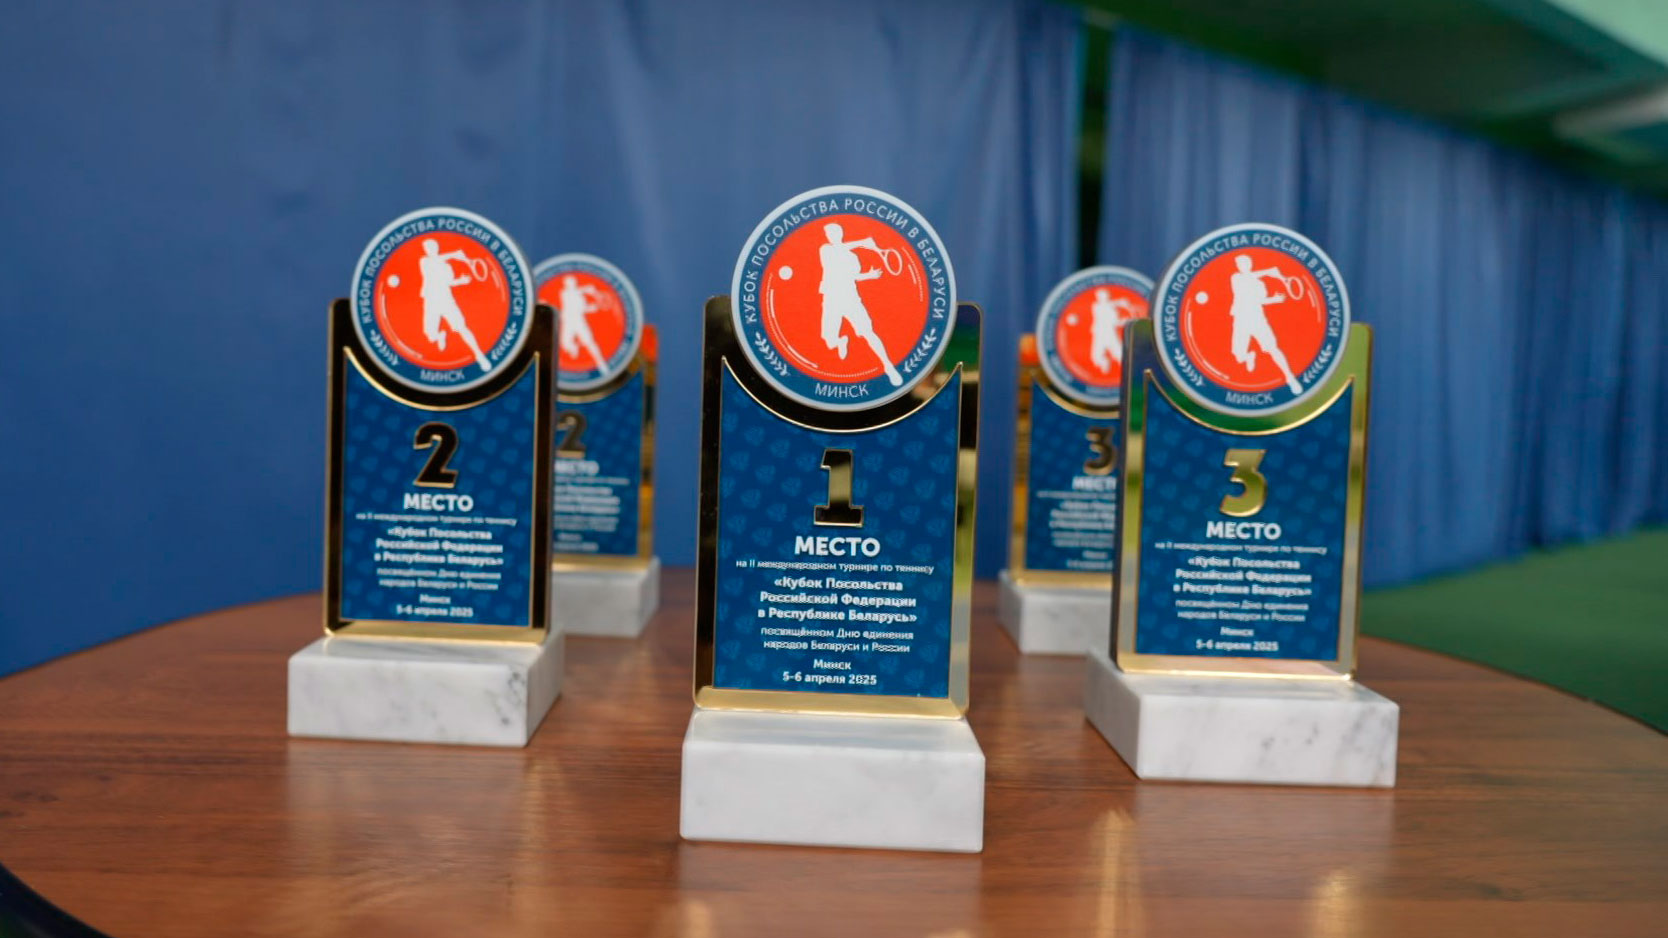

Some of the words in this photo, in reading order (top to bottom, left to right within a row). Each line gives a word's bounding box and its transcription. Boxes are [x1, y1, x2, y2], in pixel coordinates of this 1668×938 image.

[438, 218, 491, 242] РОССИИ
[365, 219, 435, 277] ПОСОЛЬСТВА
[490, 240, 500, 250] В
[744, 271, 757, 323] КУБОК
[752, 199, 839, 267] ПОСОЛЬСТВА
[845, 199, 908, 229] РОССИИ
[908, 226, 919, 237] В
[917, 239, 946, 319] БЕЛАРУСИ
[499, 250, 522, 316] БЕЛАРУСИ
[1165, 295, 1177, 341] КУБОК
[1172, 235, 1248, 293] ПОСОЛЬСТВА
[1253, 234, 1308, 259] РОССИИ
[1308, 258, 1317, 268] В
[1316, 268, 1341, 337] БЕЛАРУСИ
[360, 280, 371, 323] КУБОК
[420, 369, 465, 382] МИНСК
[815, 383, 869, 398] МИНСК
[1226, 392, 1273, 405] МИНСК
[557, 410, 586, 458] 2
[413, 421, 459, 488] 2
[1083, 426, 1116, 475] 3
[814, 448, 864, 527] 1
[1220, 449, 1268, 517] 3
[404, 493, 474, 512] МЕСТО
[1206, 521, 1282, 540] МЕСТО
[794, 536, 880, 557] МЕСТО
[839, 563, 878, 572] турнире
[775, 577, 822, 589] «Кубок
[826, 578, 903, 591] Посольства
[760, 592, 838, 605] Российской
[841, 593, 916, 607] Федерации
[758, 609, 765, 618] в
[769, 607, 845, 621] Республике
[849, 610, 917, 624] Беларусь»
[837, 629, 860, 638] Дню
[863, 631, 913, 639] единения
[764, 641, 808, 650] народов
[811, 640, 860, 652] Беларуси
[863, 643, 868, 651] и
[872, 642, 910, 652] России
[813, 659, 851, 670] Минск
[783, 671, 802, 682] 5-6
[805, 675, 845, 684] апреля
[849, 674, 877, 685] 2025
